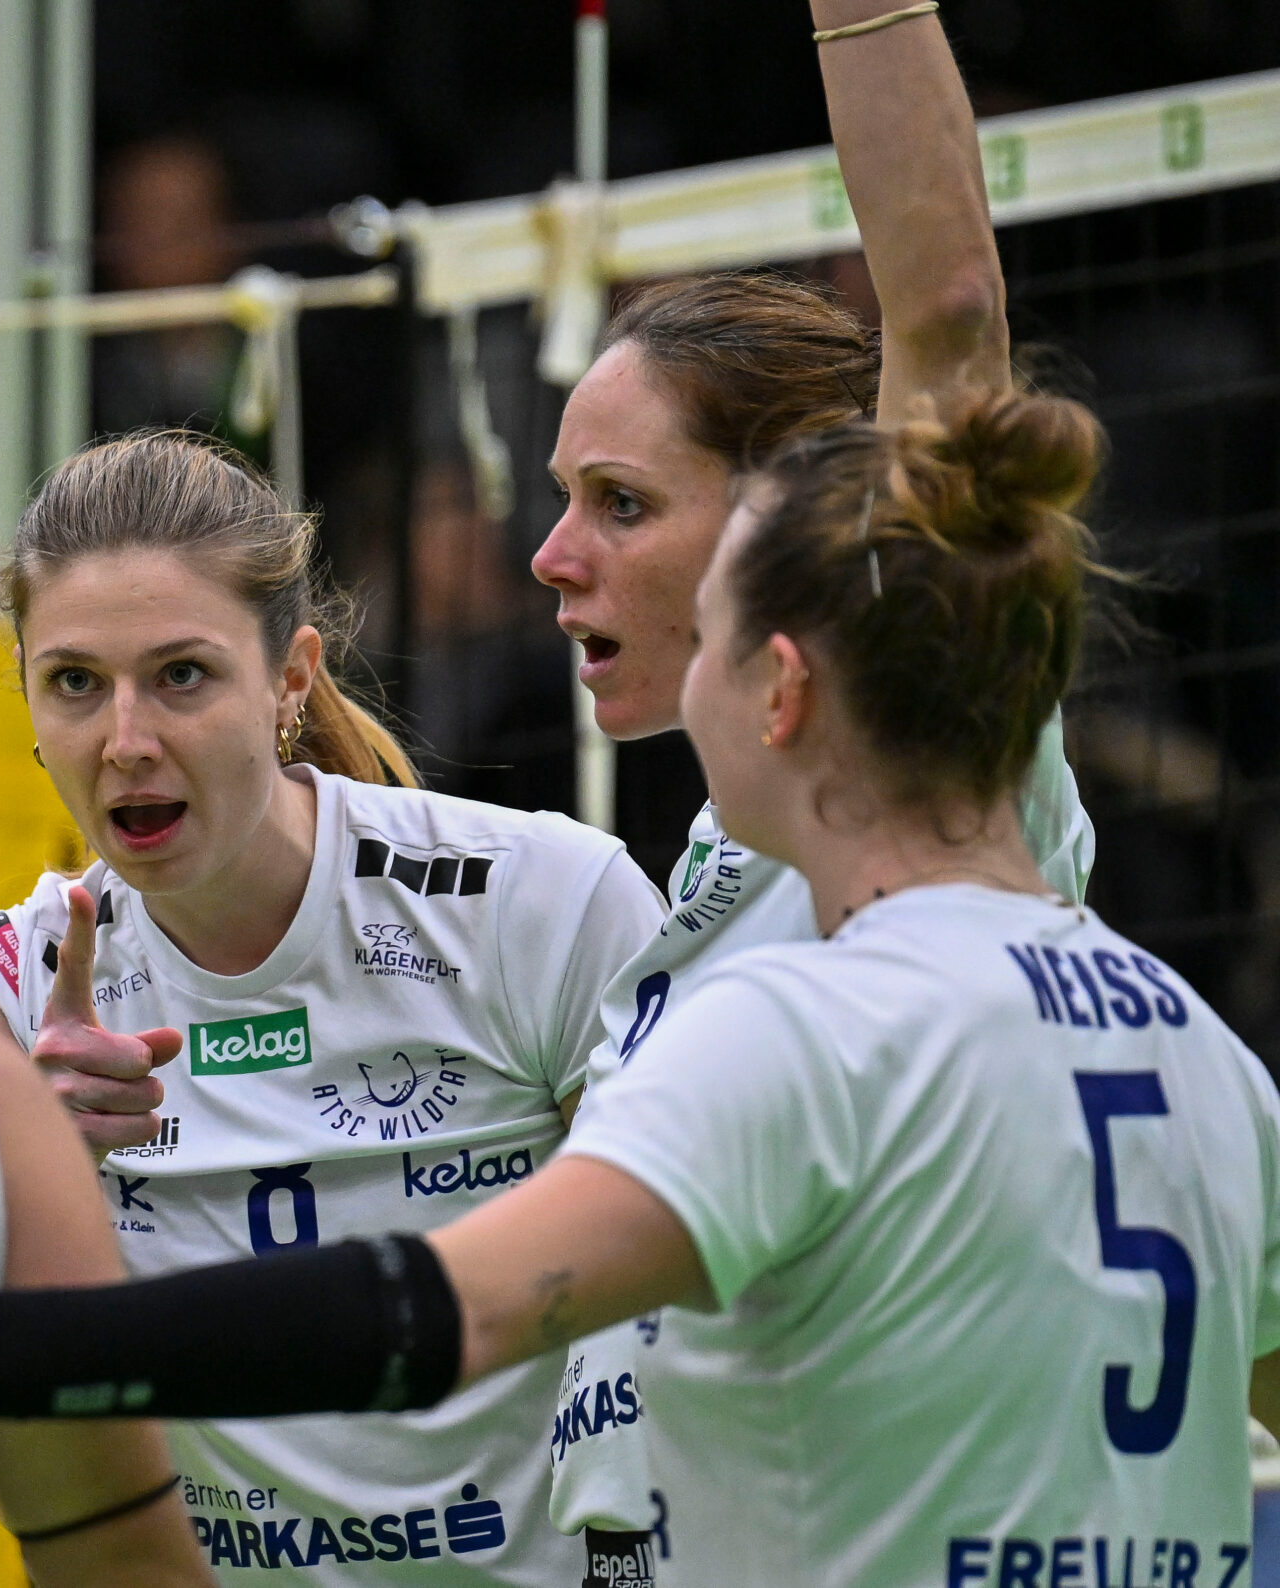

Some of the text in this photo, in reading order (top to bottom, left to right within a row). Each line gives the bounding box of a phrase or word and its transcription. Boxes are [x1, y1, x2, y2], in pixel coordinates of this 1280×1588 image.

[92, 968, 152, 1007] RNTEN
[364, 966, 437, 985] AM WÖRTHERSEE
[200, 1023, 306, 1063] kelag
[312, 1083, 367, 1137] ATSC
[111, 1145, 178, 1158] SPORT
[1073, 1071, 1198, 1455] 5
[184, 1476, 279, 1511] ärntner
[188, 1507, 442, 1570] PARKASSE
